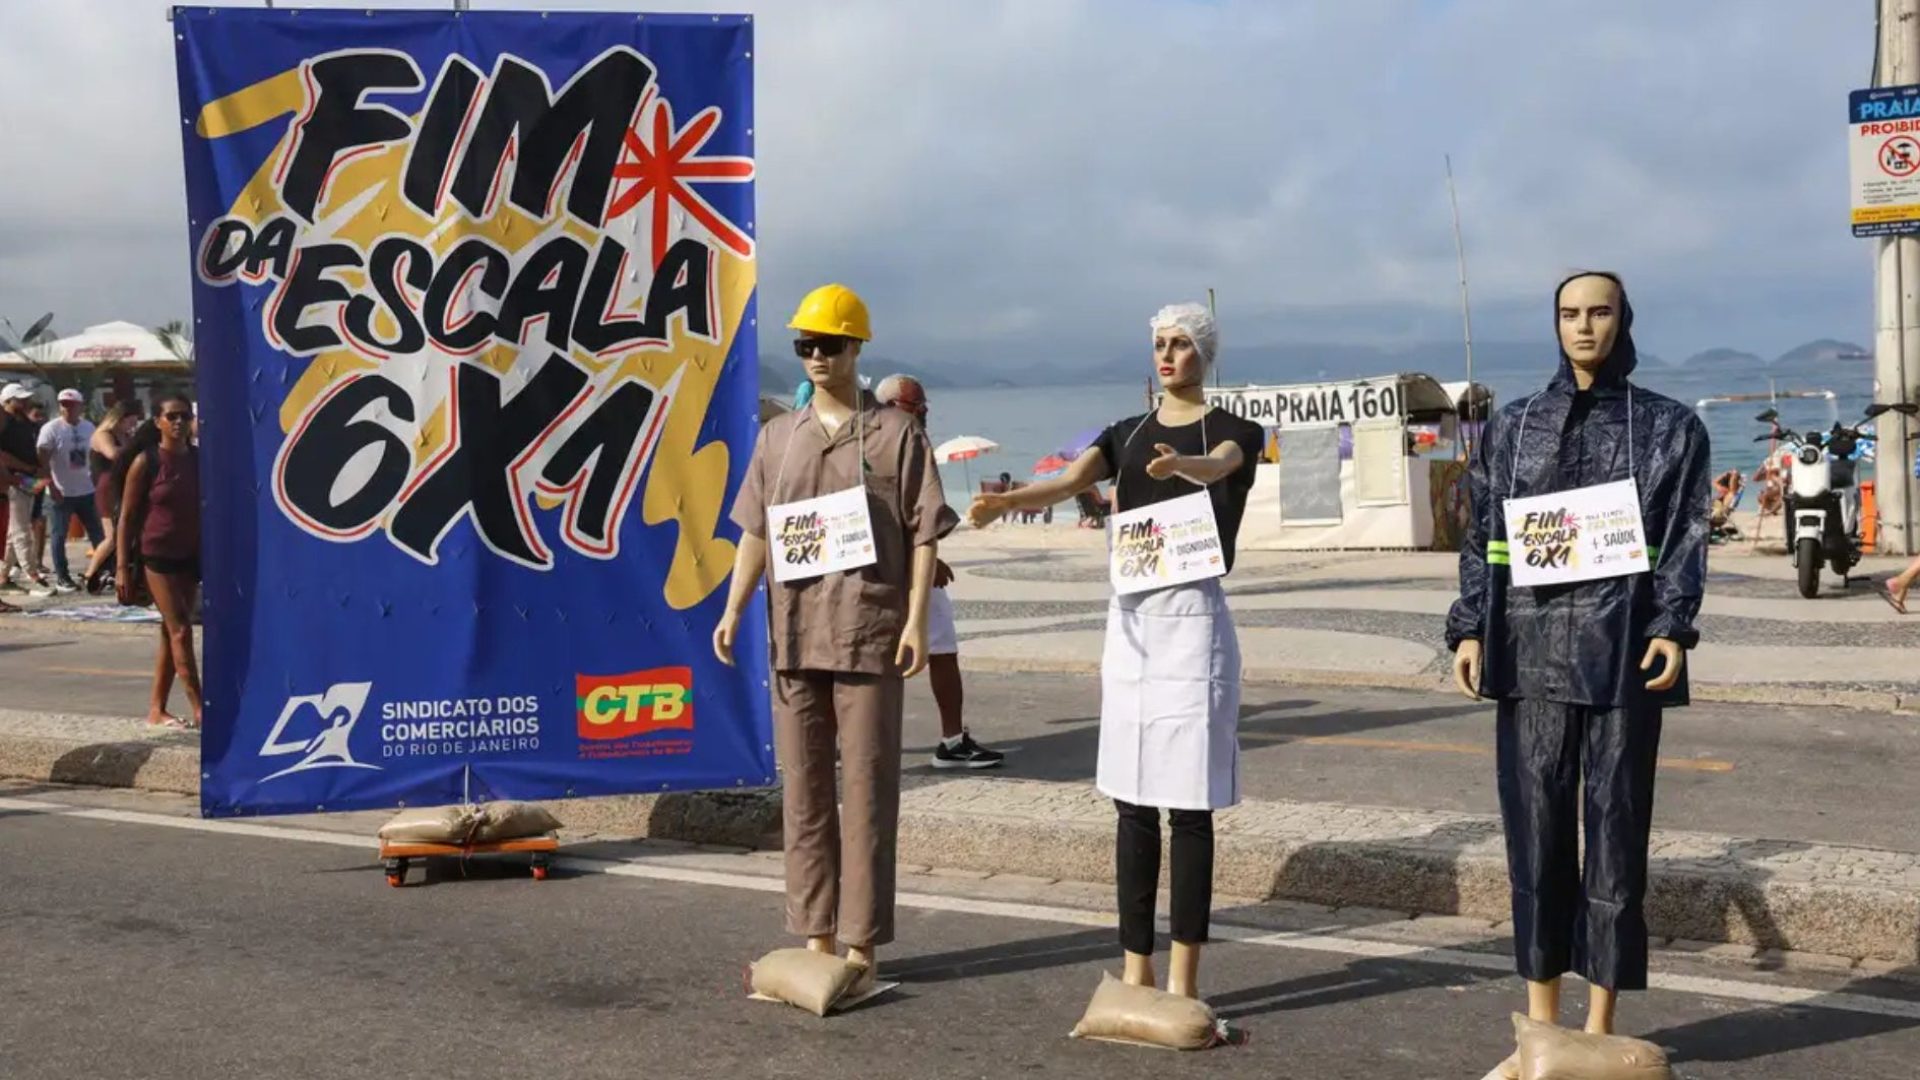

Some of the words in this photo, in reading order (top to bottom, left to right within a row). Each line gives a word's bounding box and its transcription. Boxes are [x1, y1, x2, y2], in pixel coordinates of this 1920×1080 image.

[277, 48, 658, 229] FIM
[203, 217, 297, 282] DA
[269, 236, 718, 357] ESCALA
[1250, 399, 1274, 418] DA
[1276, 389, 1345, 423] PRAIA
[1348, 387, 1396, 419] 160
[276, 351, 662, 568] 6X1
[783, 511, 818, 532] FIM
[1119, 517, 1154, 542] FIM
[1523, 507, 1567, 531] FIM
[783, 529, 827, 547] ESCALA
[1523, 528, 1579, 546] ESCALA
[785, 544, 822, 565] 6X1
[1120, 554, 1160, 577] 6X1
[1525, 545, 1572, 569] 6X1
[382, 699, 492, 720] SINDICATO
[497, 696, 539, 714] DOS
[584, 683, 685, 725] CTB
[381, 716, 540, 742] COMERCIÁRIOS
[382, 744, 405, 757] DO
[410, 742, 437, 755] RIO
[443, 741, 463, 754] DE
[468, 737, 540, 753] JANEIRO
